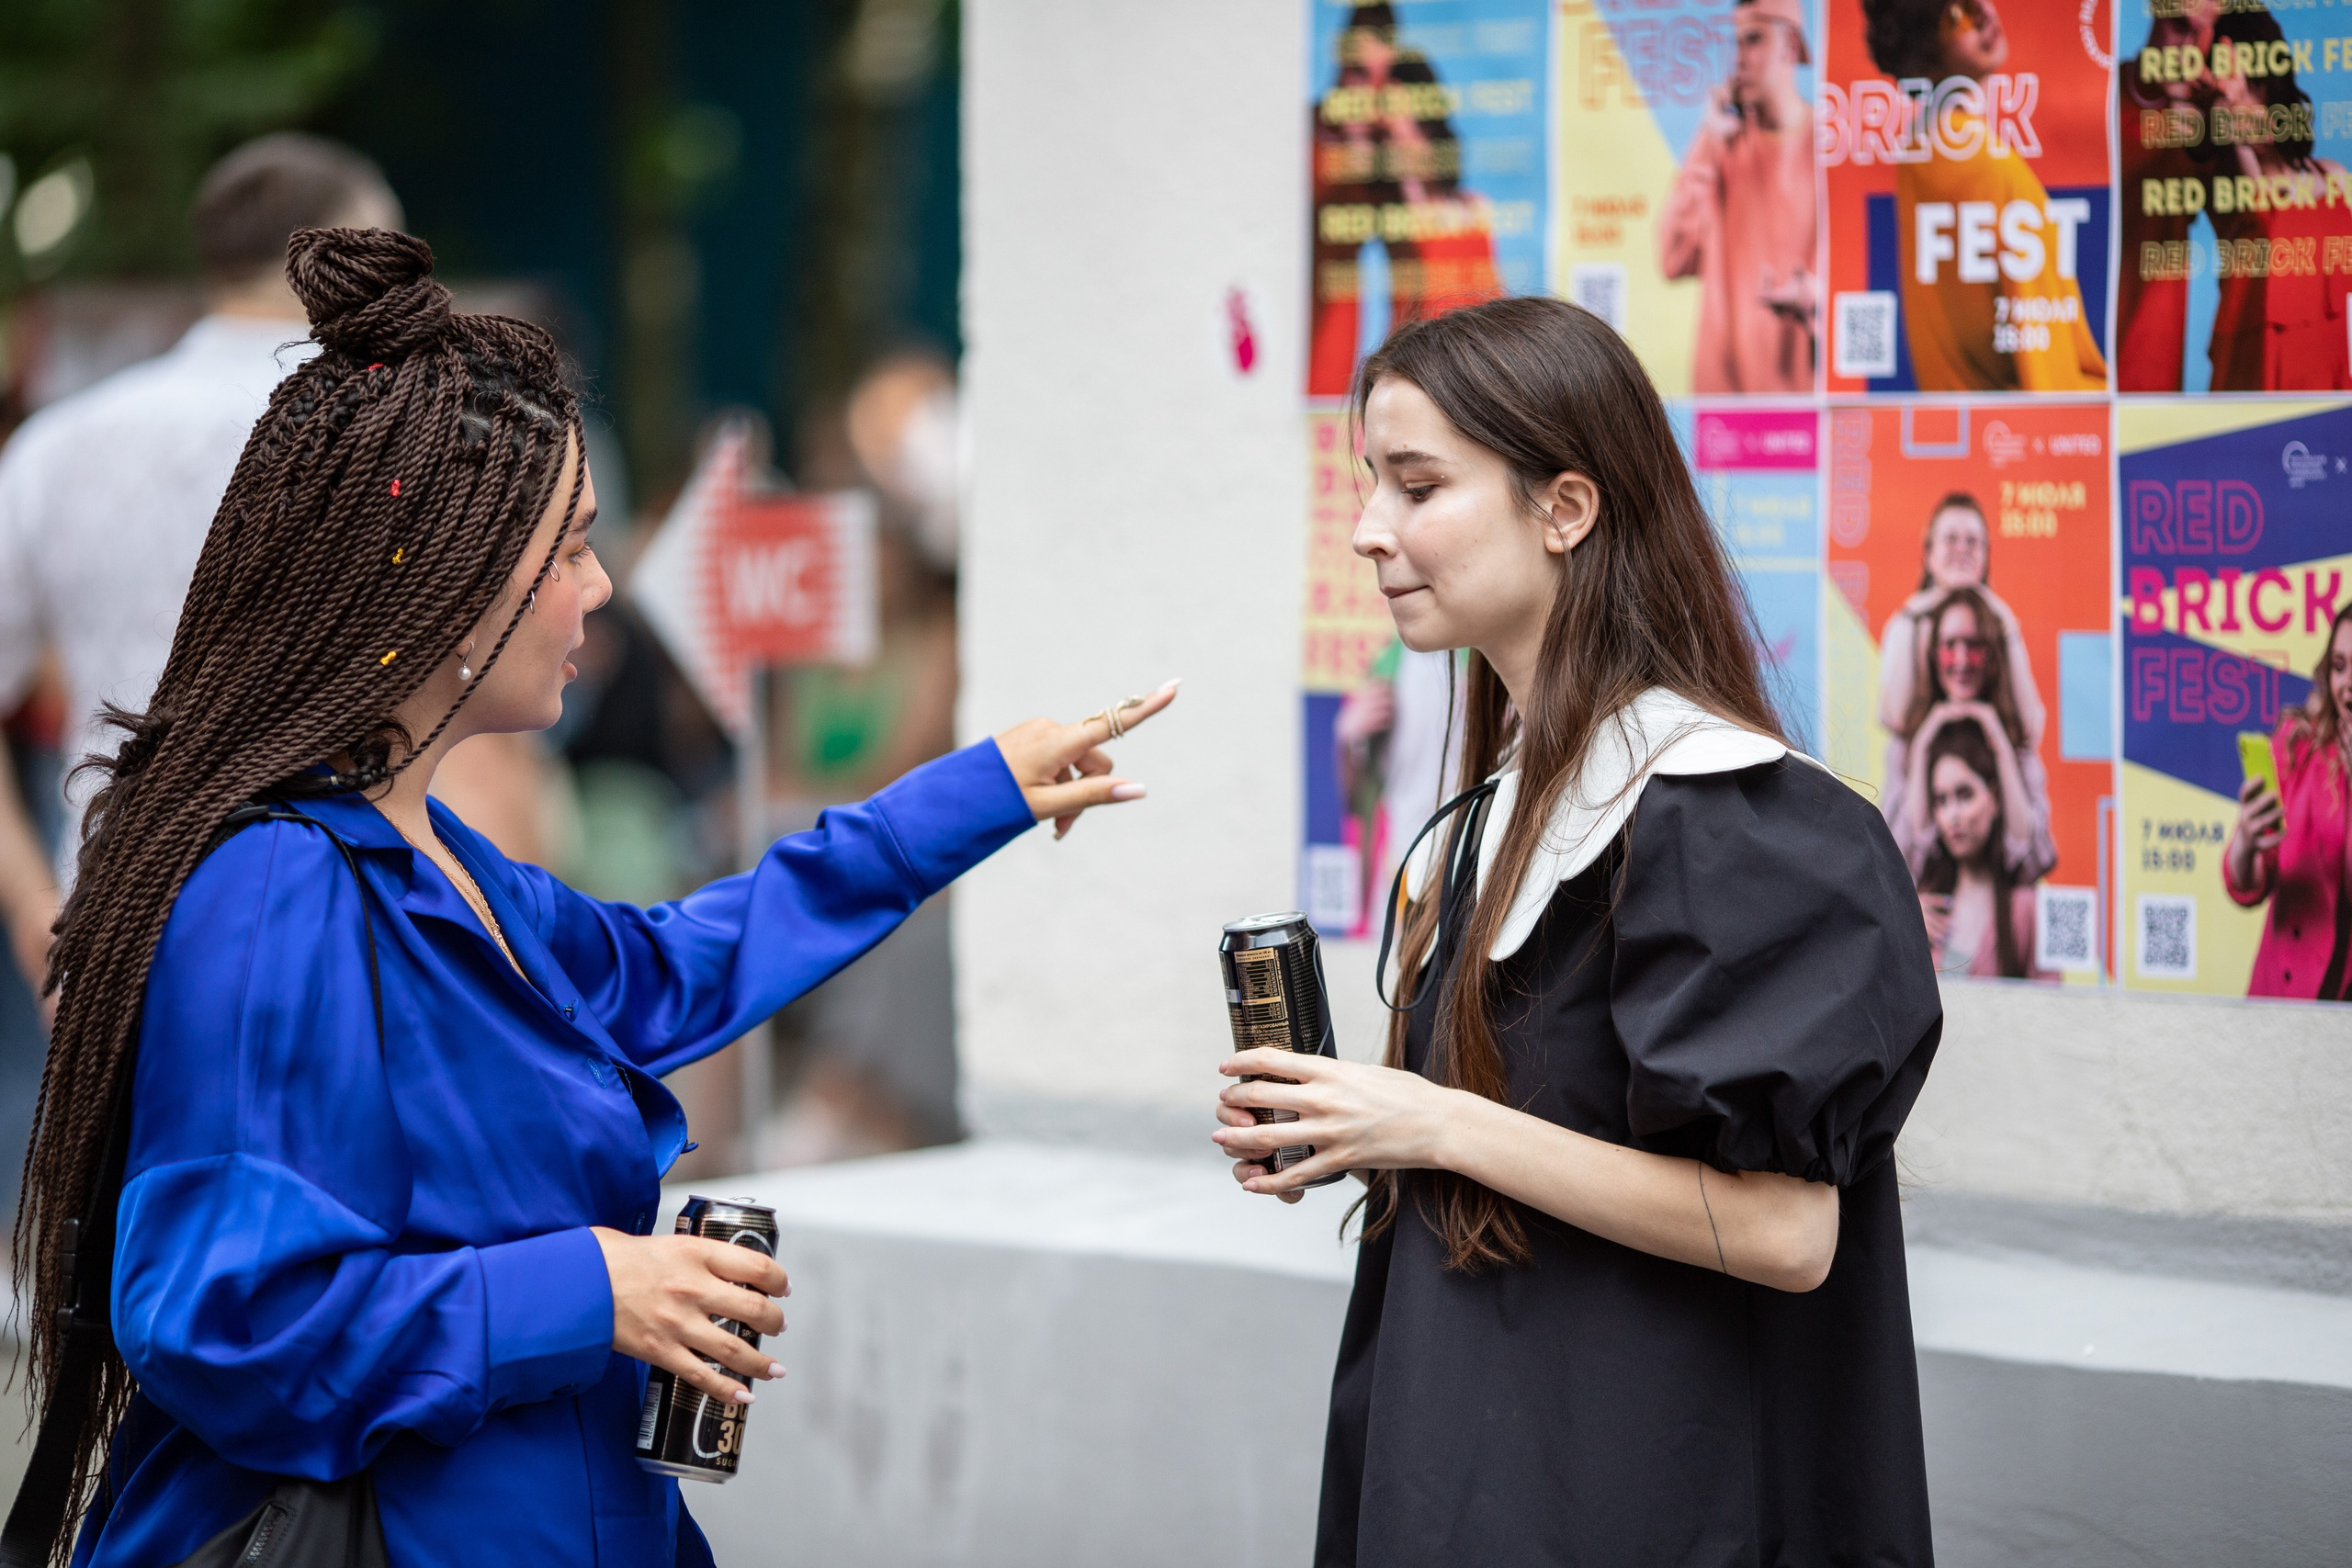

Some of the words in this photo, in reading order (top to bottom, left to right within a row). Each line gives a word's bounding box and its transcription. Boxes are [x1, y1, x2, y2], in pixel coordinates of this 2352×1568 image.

[2143, 46, 2205, 84] RED
[2211, 39, 2314, 78] BRICK
[1816, 74, 2043, 165] BRICK
[2141, 109, 2205, 149] RED
[2210, 104, 2315, 146] BRICK
[2143, 178, 2206, 216] RED
[2212, 173, 2318, 214] BRICK
[1914, 197, 2091, 284] FEST
[2142, 243, 2205, 281] RED
[2211, 236, 2318, 280] BRICK
[2129, 479, 2265, 556] RED
[722, 539, 825, 626] WC
[2129, 566, 2343, 637] BRICK
[2131, 646, 2290, 725] FEST
[716, 1457, 738, 1467] SUGA
